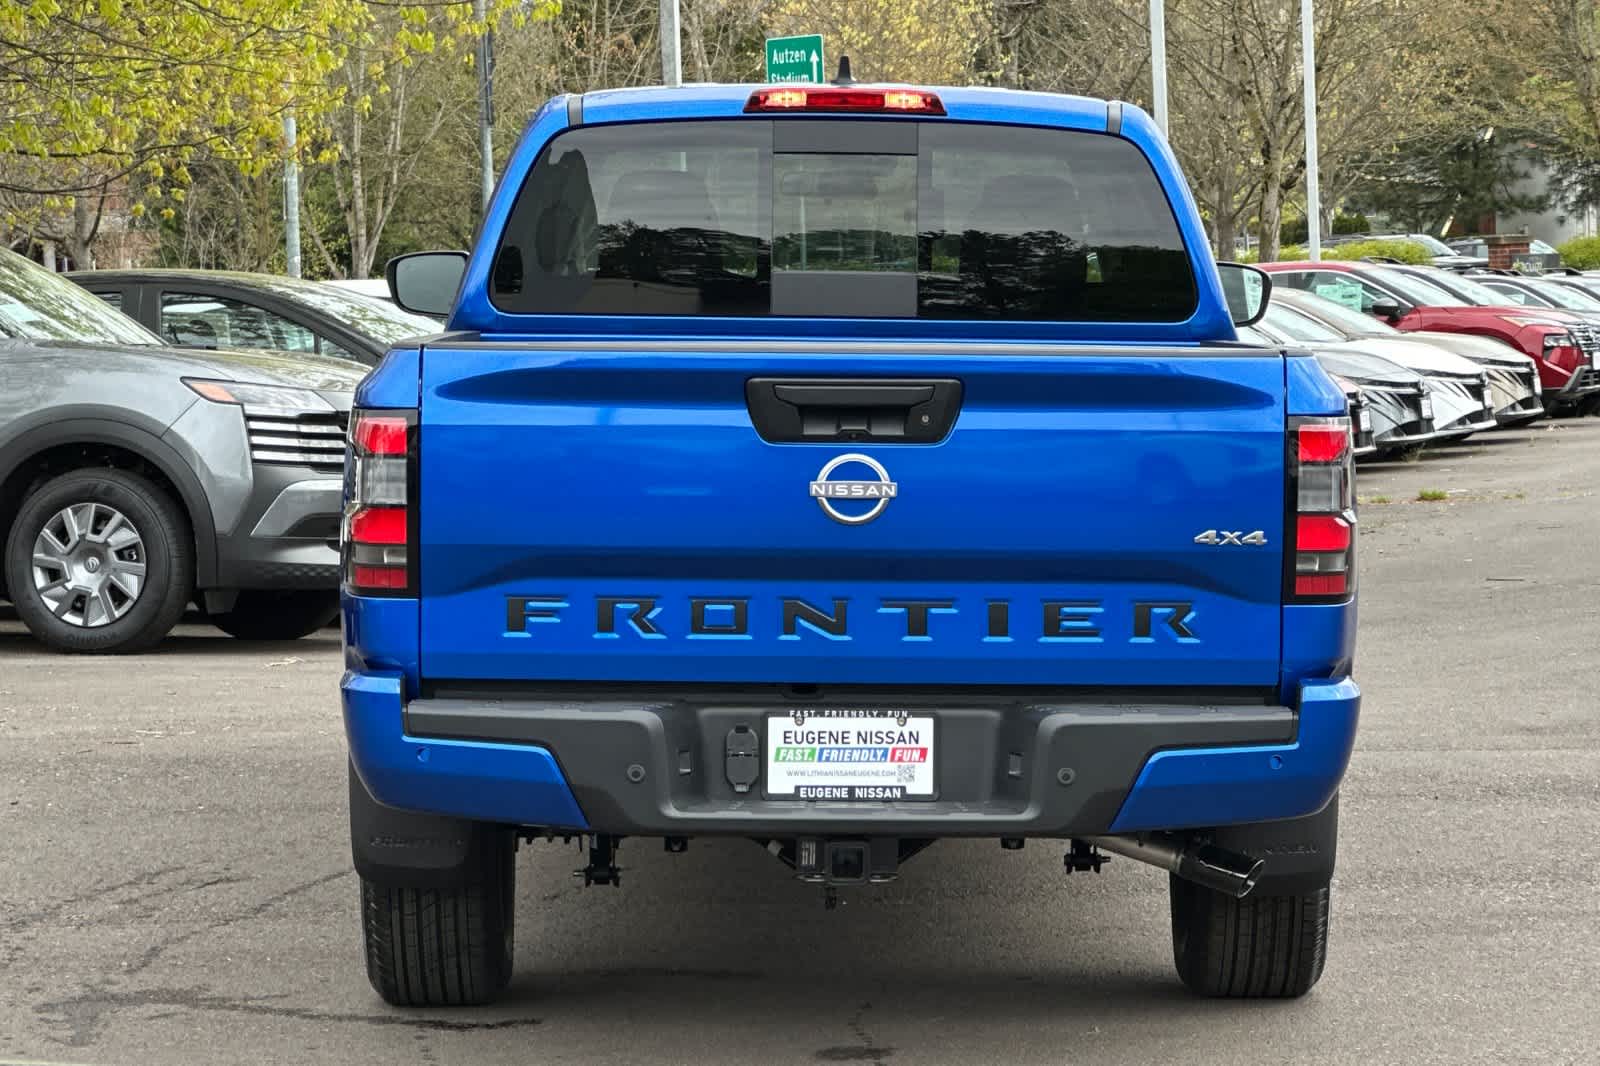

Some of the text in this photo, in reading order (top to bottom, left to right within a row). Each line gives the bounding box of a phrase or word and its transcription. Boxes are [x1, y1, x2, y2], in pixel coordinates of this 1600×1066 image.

[772, 48, 807, 64] Autzen
[812, 484, 896, 496] NISSAN
[502, 595, 1201, 643] FRONTIER
[783, 730, 919, 745] EUGENE NISSAN
[894, 748, 925, 761] FUN.
[800, 787, 901, 798] EUGENE NISSAN
